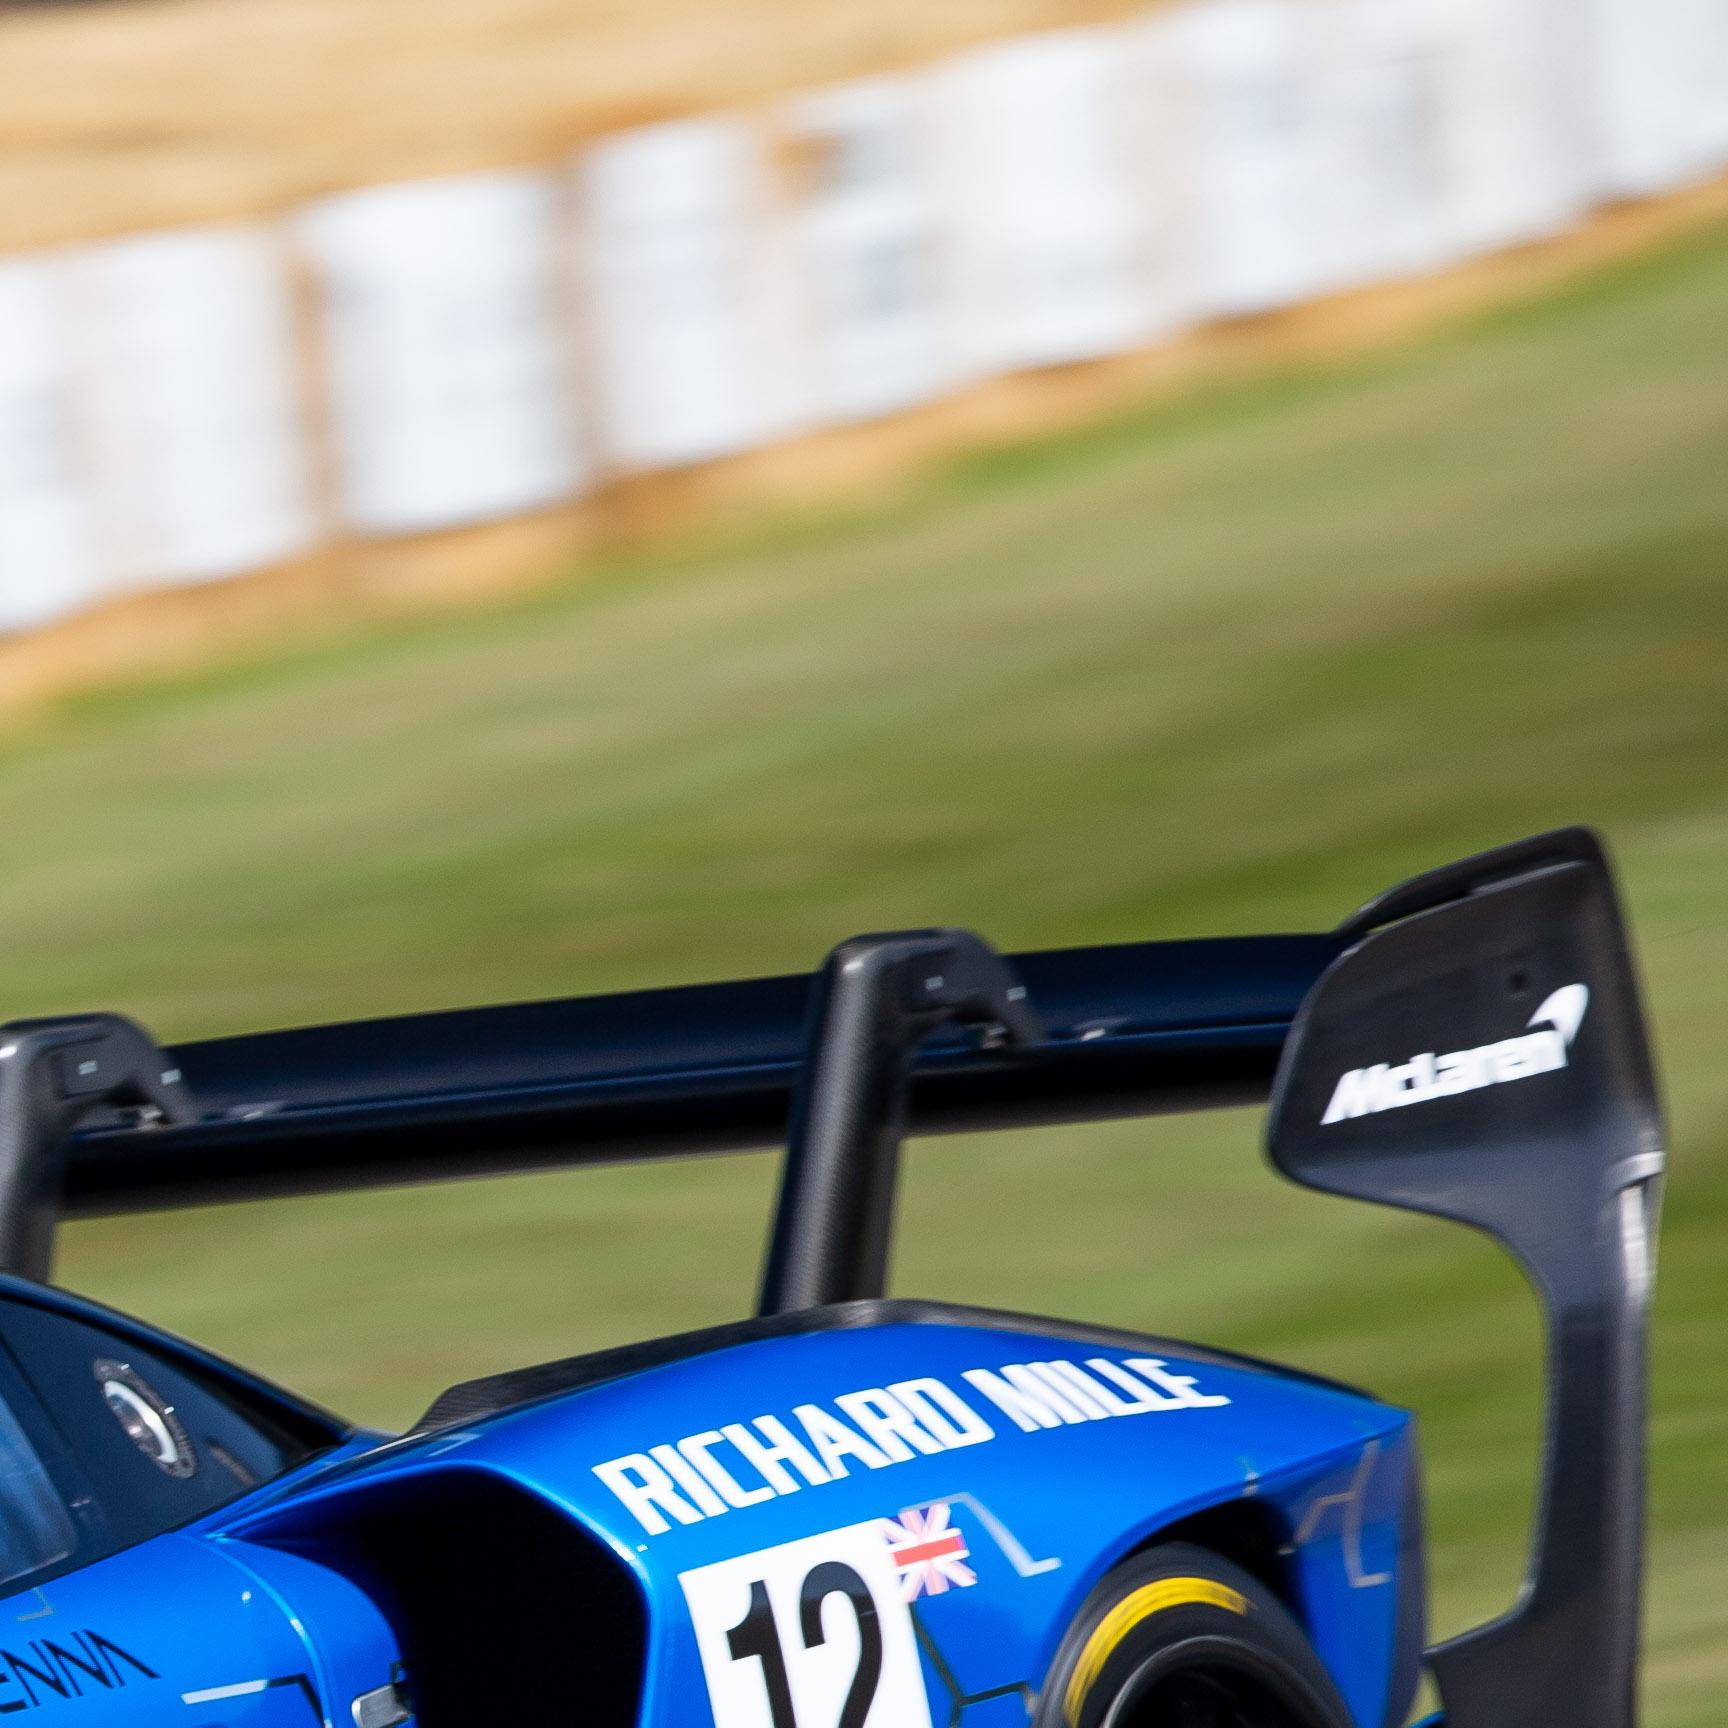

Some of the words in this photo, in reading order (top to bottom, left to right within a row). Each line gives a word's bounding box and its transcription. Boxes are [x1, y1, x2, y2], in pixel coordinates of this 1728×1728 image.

[1320, 1029, 1568, 1126] McLaren
[592, 1376, 996, 1537] RICHARD
[962, 1356, 1233, 1434] MILLE
